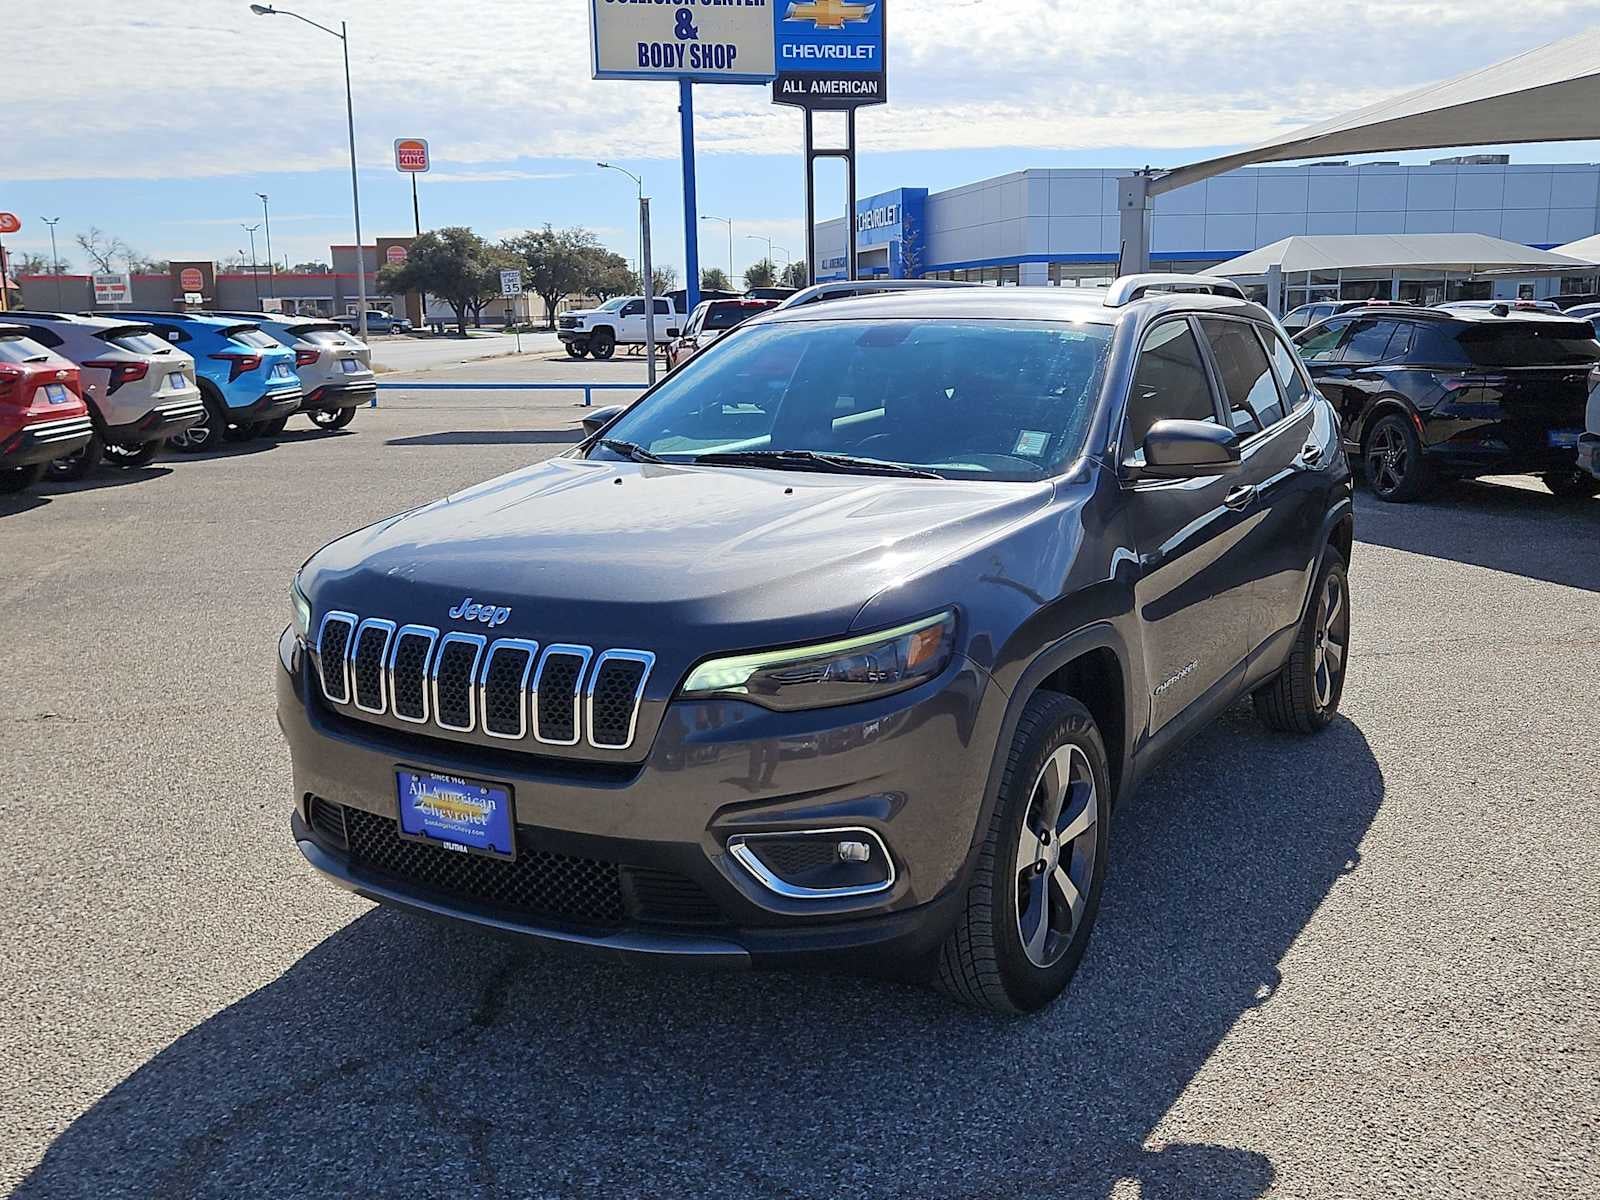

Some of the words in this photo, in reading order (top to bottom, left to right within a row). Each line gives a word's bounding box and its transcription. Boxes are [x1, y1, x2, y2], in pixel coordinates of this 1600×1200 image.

[674, 8, 699, 40] &
[637, 43, 684, 68] BODY
[690, 44, 737, 69] SHOP
[782, 44, 875, 60] CHEVROLET
[782, 80, 807, 94] ALL
[810, 81, 878, 94] AMERICAN
[399, 156, 425, 165] KING
[858, 204, 898, 231] CHEVROLET
[504, 283, 520, 293] 35
[449, 597, 512, 628] Jeep
[430, 773, 449, 783] SINCE
[409, 782, 426, 796] All
[432, 786, 496, 810] American
[421, 801, 488, 826] Chevrolet
